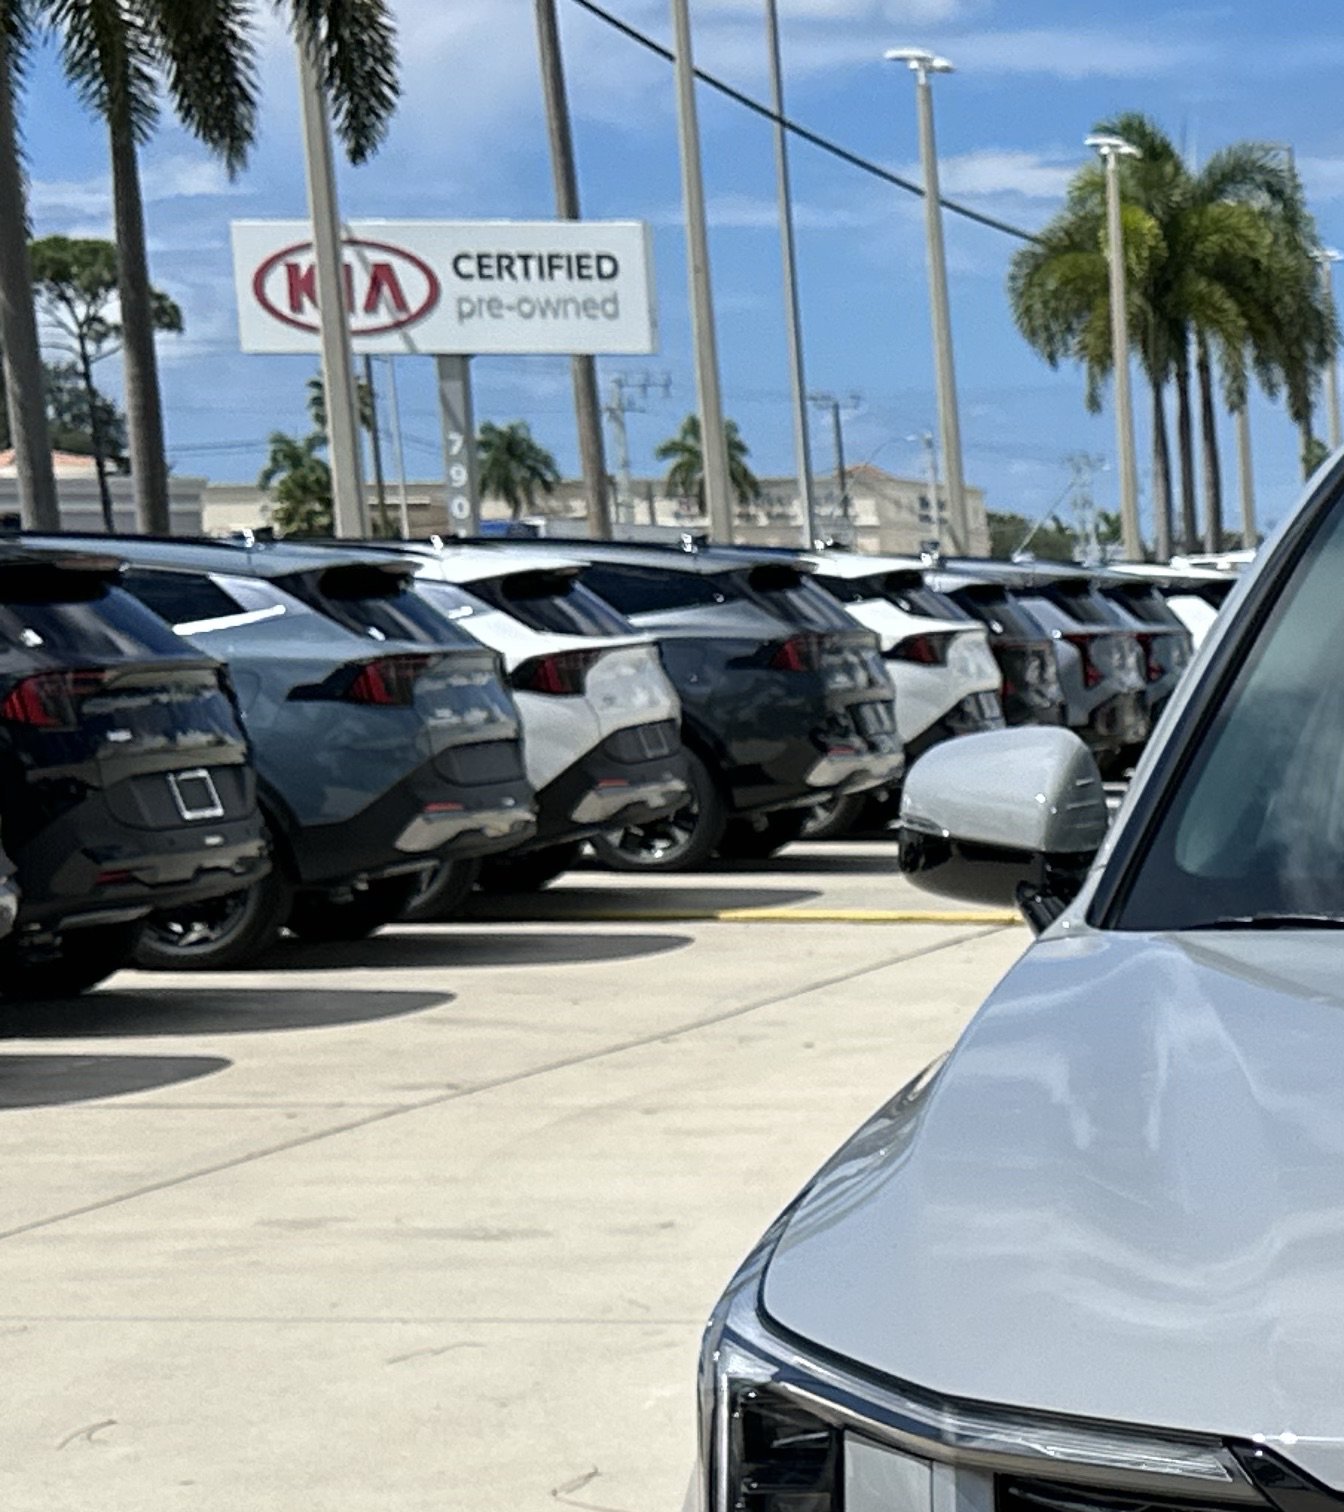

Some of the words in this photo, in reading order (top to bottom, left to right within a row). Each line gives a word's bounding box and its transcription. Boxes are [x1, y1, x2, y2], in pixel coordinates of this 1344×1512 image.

[452, 252, 620, 281] CERTIFIED
[457, 291, 620, 324] pre-owned
[448, 431, 470, 537] 790
